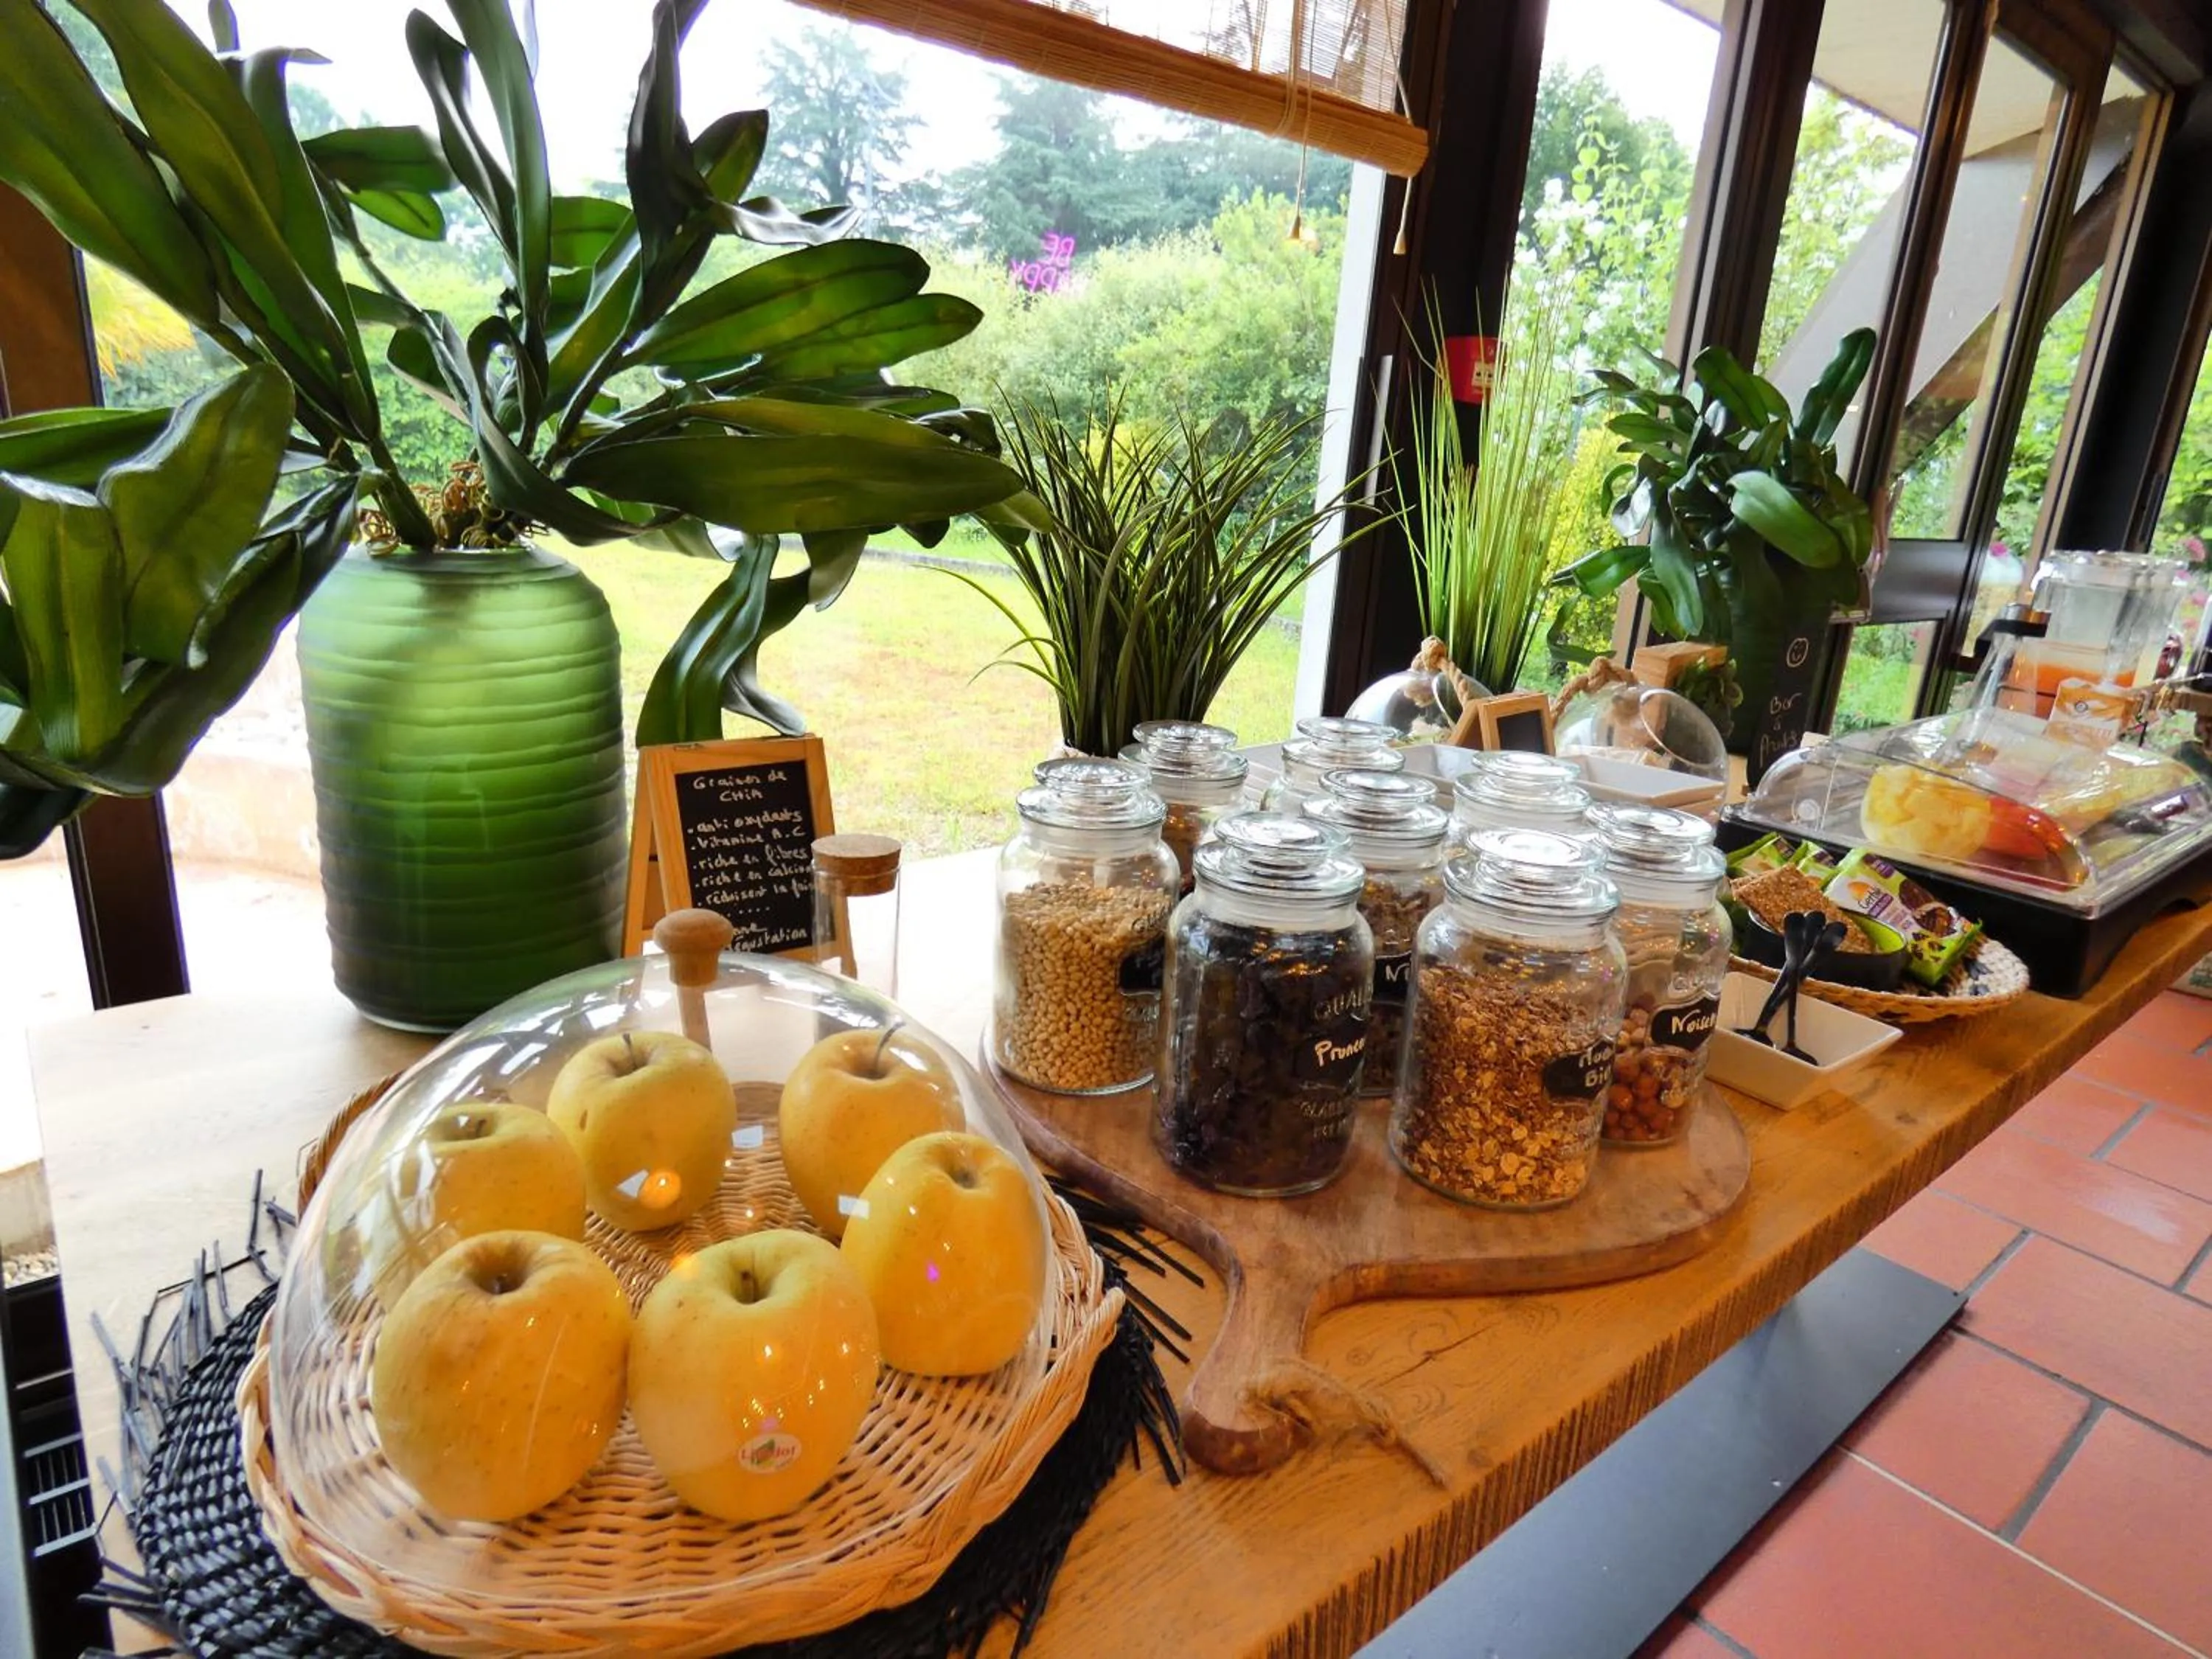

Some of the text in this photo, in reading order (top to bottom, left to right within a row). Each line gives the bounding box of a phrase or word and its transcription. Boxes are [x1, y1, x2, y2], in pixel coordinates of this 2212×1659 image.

[768, 769, 787, 782] de
[699, 844, 809, 869] riche en fibres
[701, 872, 741, 887] riche
[748, 871, 762, 880] en
